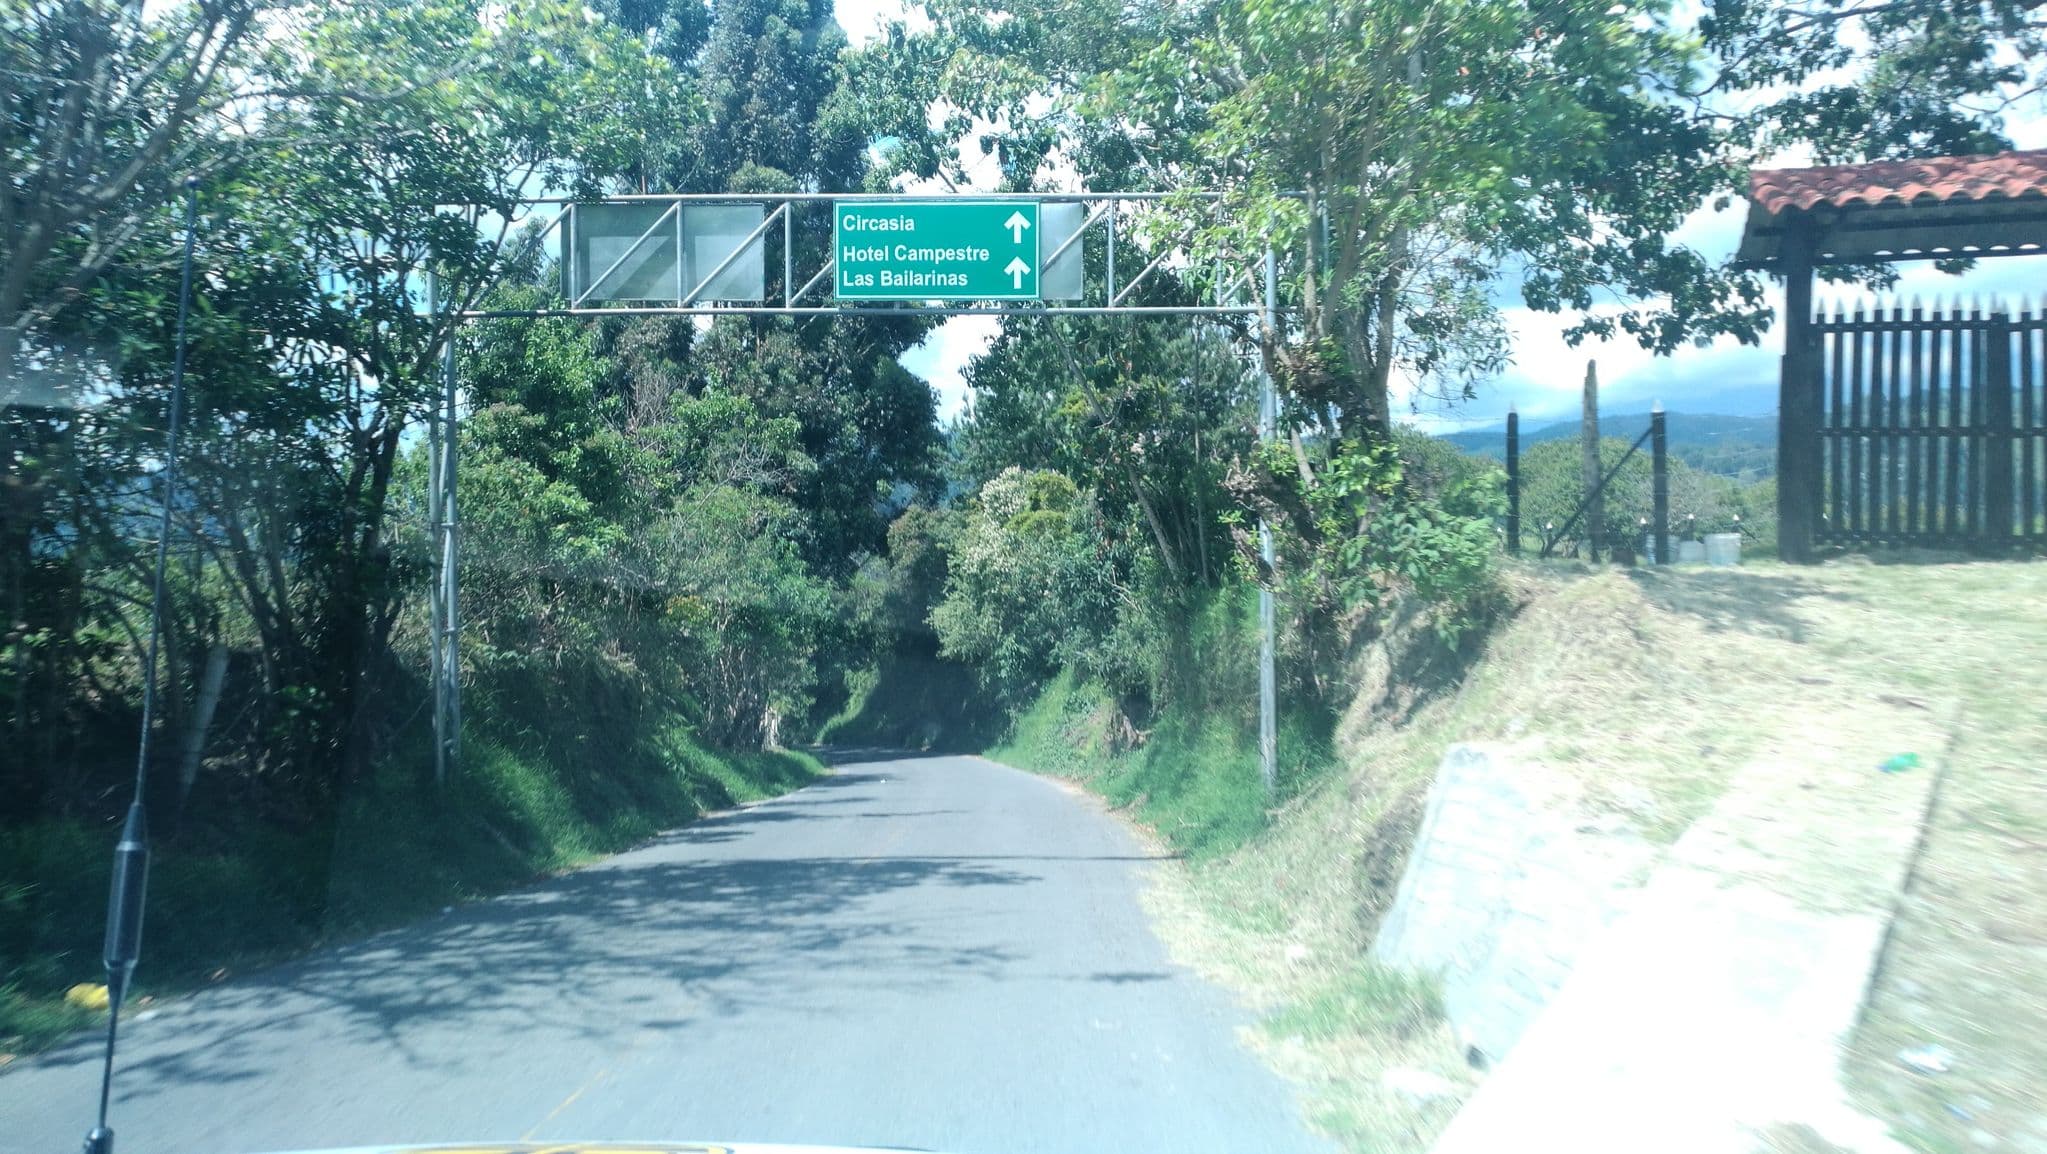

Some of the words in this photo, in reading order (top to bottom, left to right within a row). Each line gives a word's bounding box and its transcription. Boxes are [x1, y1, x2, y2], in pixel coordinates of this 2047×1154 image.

[843, 215, 915, 231] Circasia
[843, 245, 889, 262] Hotel
[894, 245, 990, 264] Campestre
[843, 271, 874, 286] Las
[880, 270, 968, 286] Bailarinas
